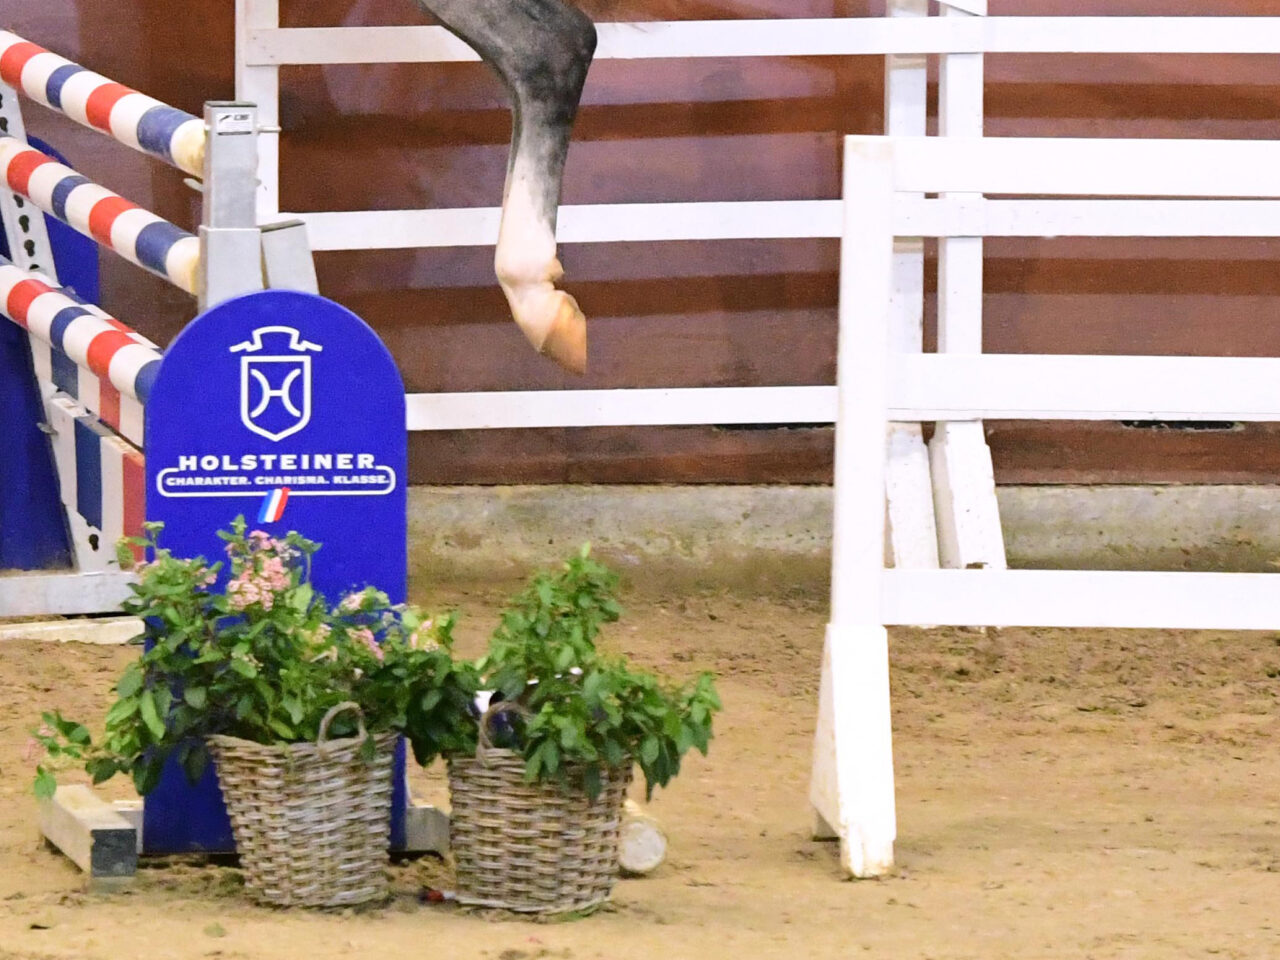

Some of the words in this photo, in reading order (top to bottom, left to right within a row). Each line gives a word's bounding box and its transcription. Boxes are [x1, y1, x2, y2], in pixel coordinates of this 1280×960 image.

[178, 453, 376, 471] HOLSTEINER
[165, 476, 252, 486] CHARAKTER.
[254, 475, 330, 485] CHARISMA.
[333, 474, 390, 485] KLASSE.
